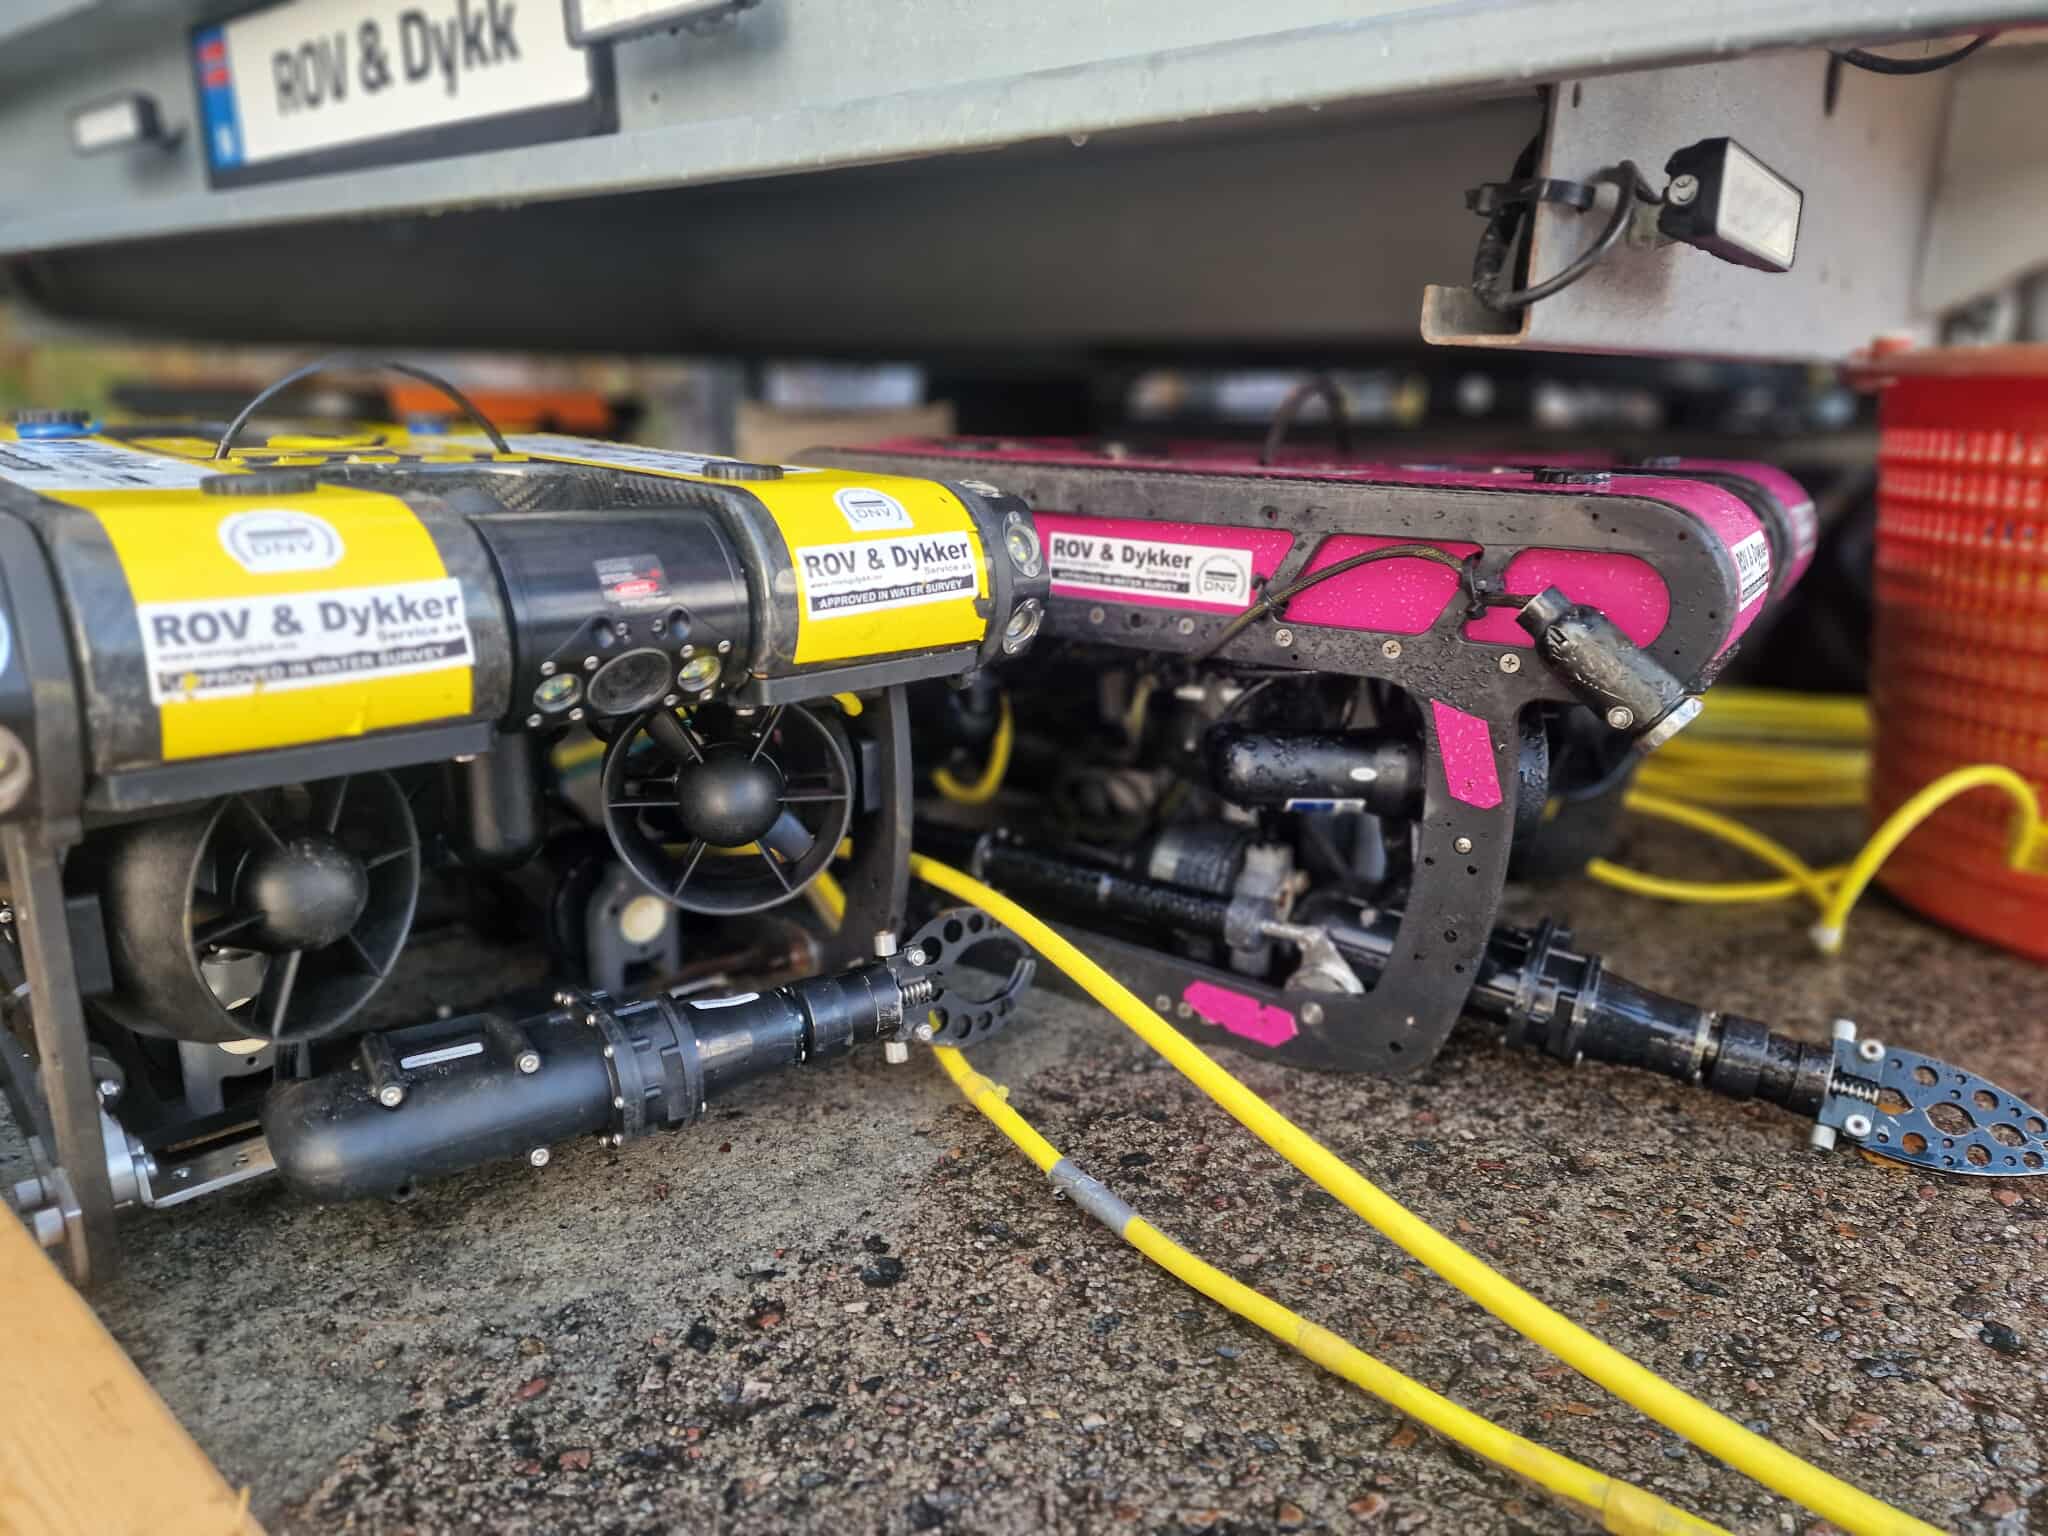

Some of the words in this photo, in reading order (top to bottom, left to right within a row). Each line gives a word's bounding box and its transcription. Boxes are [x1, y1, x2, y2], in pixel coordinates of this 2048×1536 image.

[271, 32, 347, 116] ROV
[357, 19, 393, 95] &
[398, 0, 520, 97] Dykk
[855, 507, 891, 519] DNV
[803, 551, 856, 578] ROV
[867, 547, 885, 570] &
[890, 541, 968, 572] Dykker
[1053, 538, 1093, 559] ROV
[1100, 543, 1114, 561] &
[1121, 545, 1193, 569] Dykker
[819, 589, 876, 608] APPROVED
[878, 590, 889, 600] IN
[890, 583, 924, 599] WATER
[925, 580, 962, 593] SURVEY
[1203, 580, 1238, 594] DNV
[150, 609, 250, 648] ROV
[271, 603, 304, 637] &
[318, 594, 459, 637] Dykker
[311, 656, 375, 674] WATER
[379, 646, 446, 666] SURVEY
